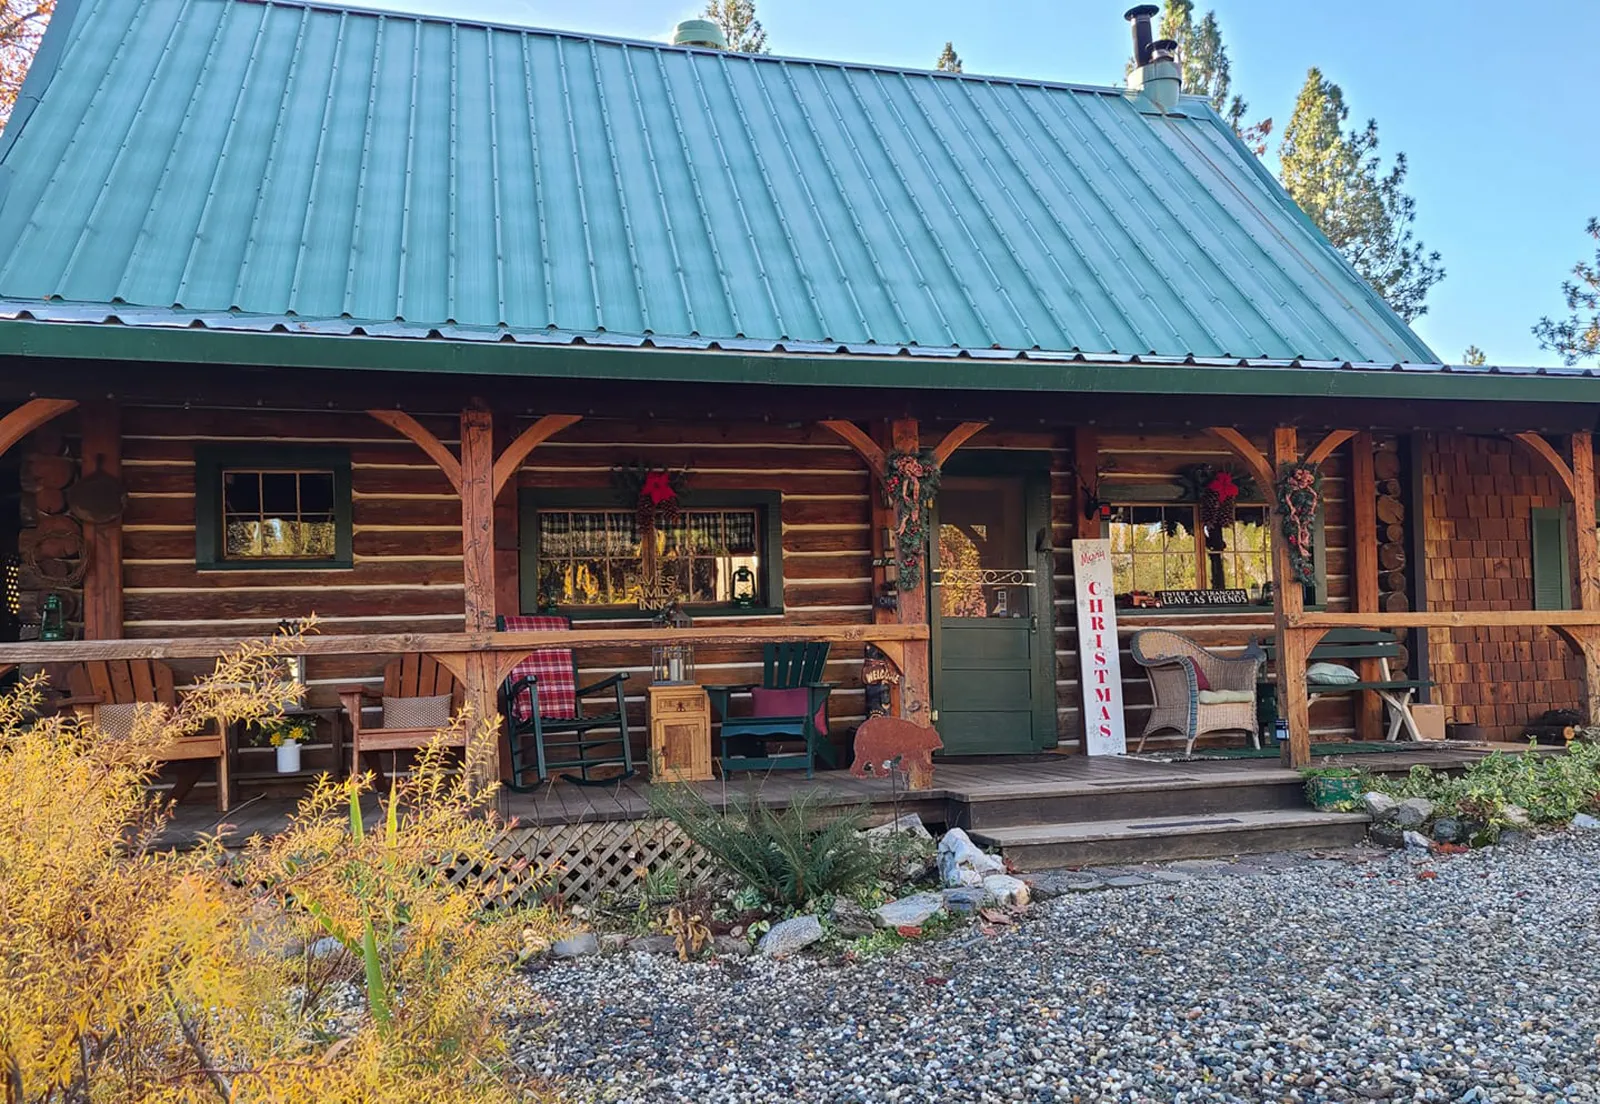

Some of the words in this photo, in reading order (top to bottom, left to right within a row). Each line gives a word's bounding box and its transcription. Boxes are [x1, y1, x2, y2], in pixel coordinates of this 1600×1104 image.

[1081, 550, 1105, 566] Merry
[639, 599, 664, 611] INN
[1162, 597, 1191, 605] LEAVE
[1193, 595, 1205, 604] AS
[1208, 595, 1247, 604] FRIENDS
[1088, 581, 1112, 738] CHRISTMAS
[865, 669, 900, 684] WELCOME
